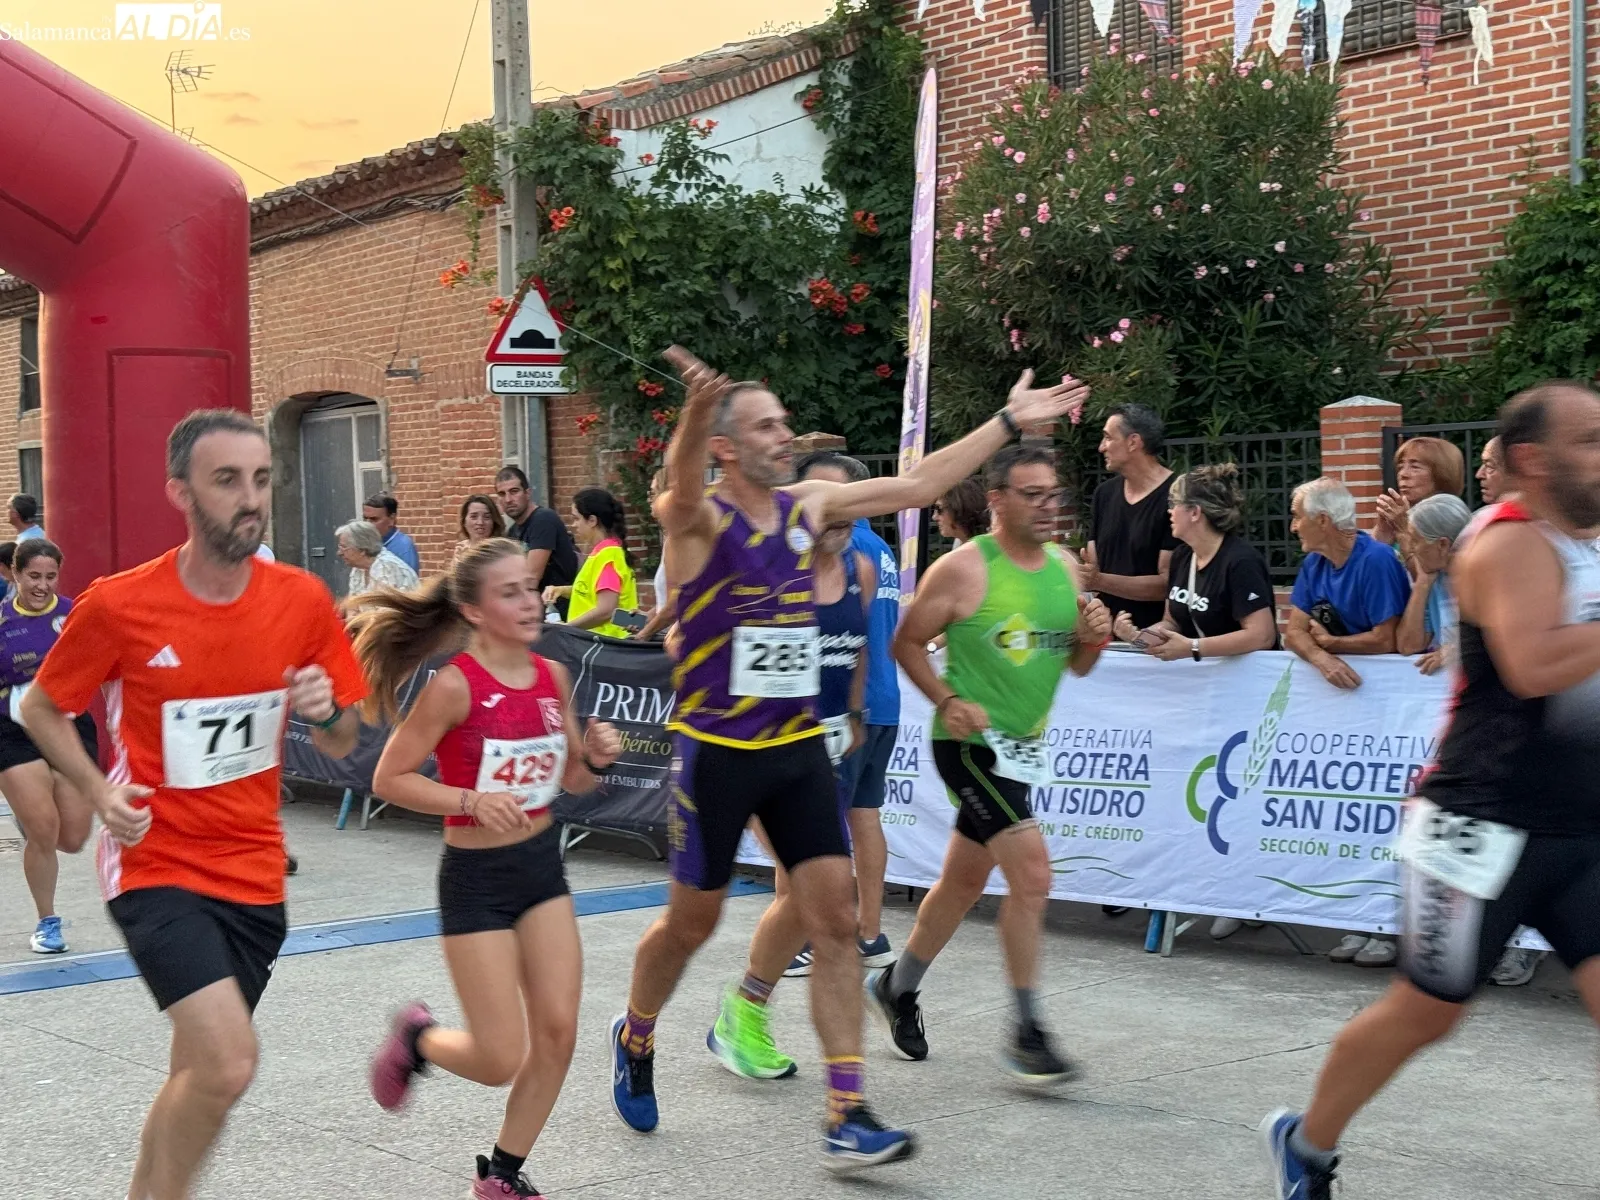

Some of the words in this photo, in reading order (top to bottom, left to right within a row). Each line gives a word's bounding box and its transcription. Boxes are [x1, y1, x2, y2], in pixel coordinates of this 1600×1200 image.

[516, 370, 553, 379] BANDAS
[589, 682, 677, 725] PRIM
[199, 711, 256, 755] 71
[492, 752, 556, 786] 429
[889, 746, 919, 772] RA
[1053, 751, 1150, 781] COTERA
[1060, 786, 1146, 819] ISIDRO
[1261, 796, 1325, 830] SAN
[1061, 823, 1078, 838] DE
[1085, 824, 1144, 842] CRÉDITO
[1259, 837, 1329, 857] SECCIÓN
[1339, 843, 1361, 860] DE
